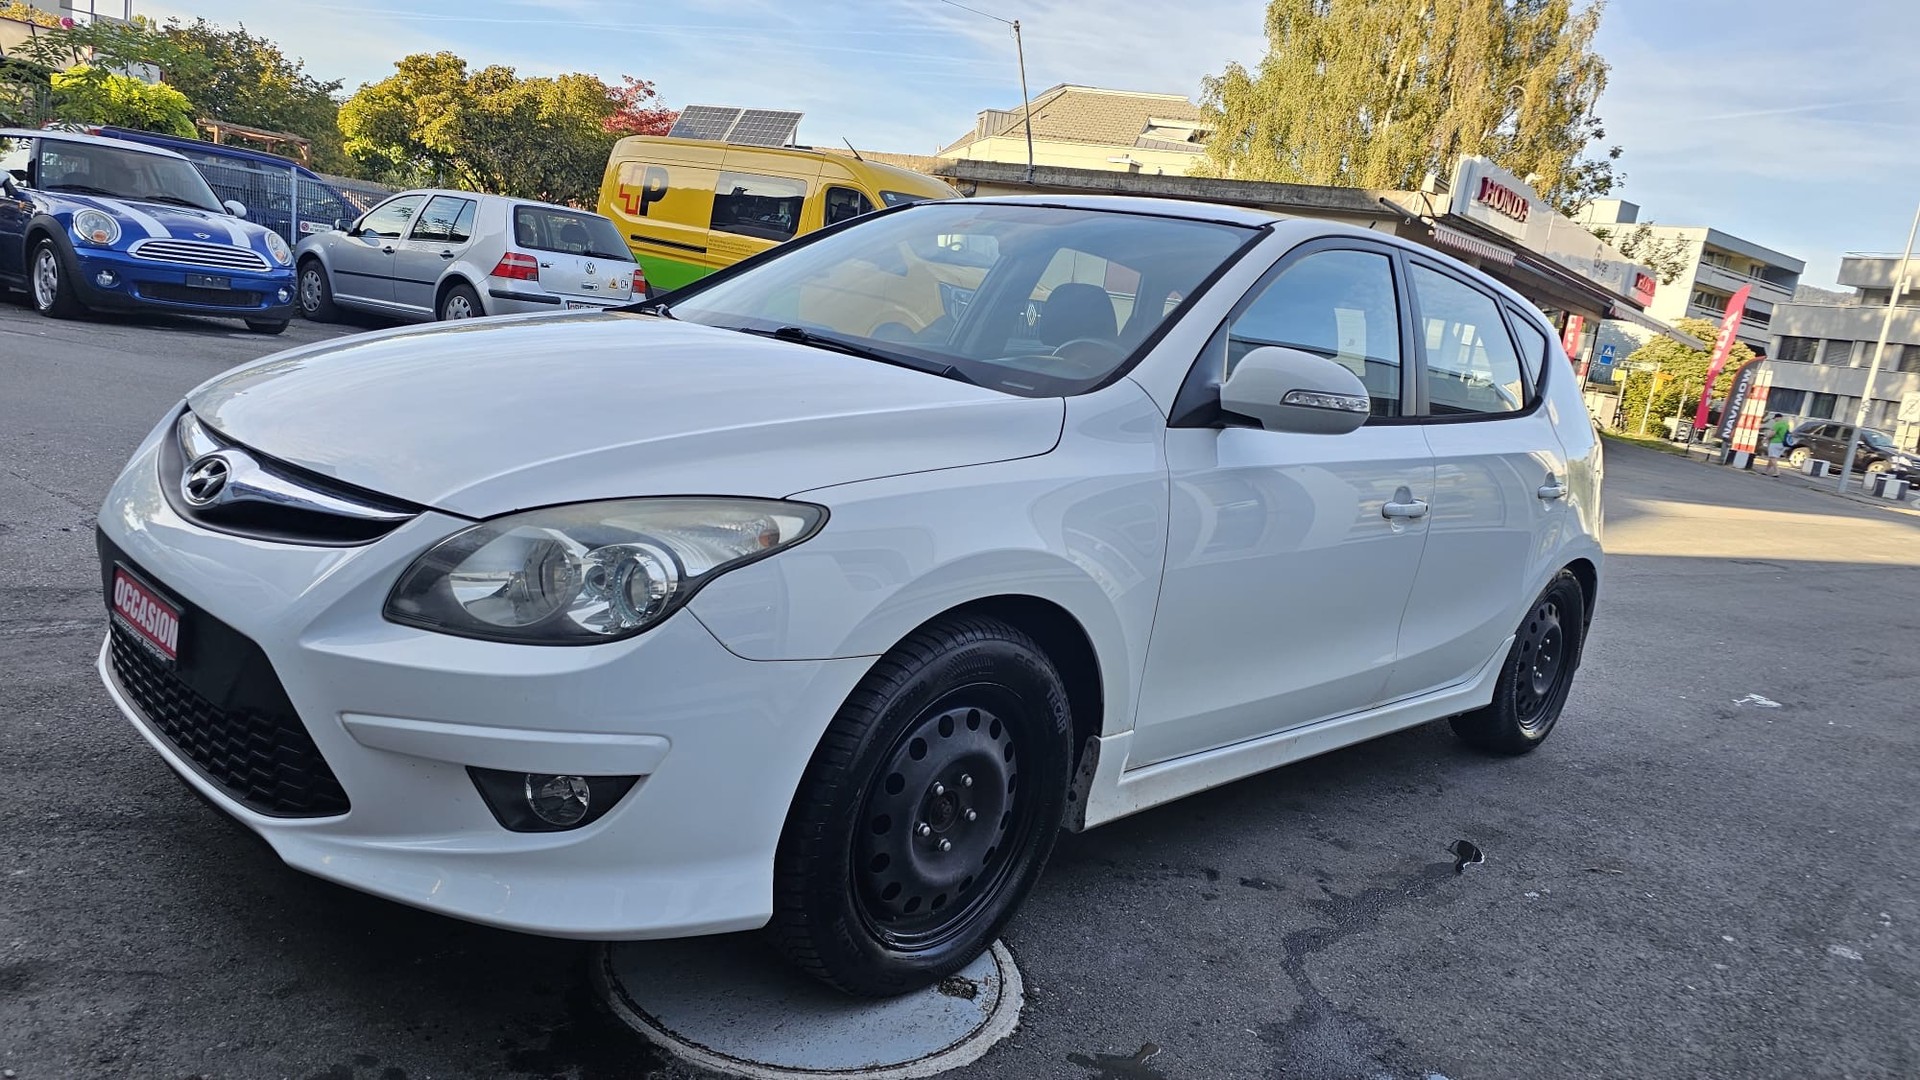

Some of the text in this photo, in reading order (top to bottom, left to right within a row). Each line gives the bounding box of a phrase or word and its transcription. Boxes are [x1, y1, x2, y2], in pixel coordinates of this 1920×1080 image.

[639, 166, 669, 217] P
[1478, 177, 1529, 222] HONDA
[620, 279, 629, 289] CH
[1721, 368, 1752, 439] NAVIMOW
[114, 576, 179, 652] OCCASION
[1046, 684, 1067, 734] TECAR
